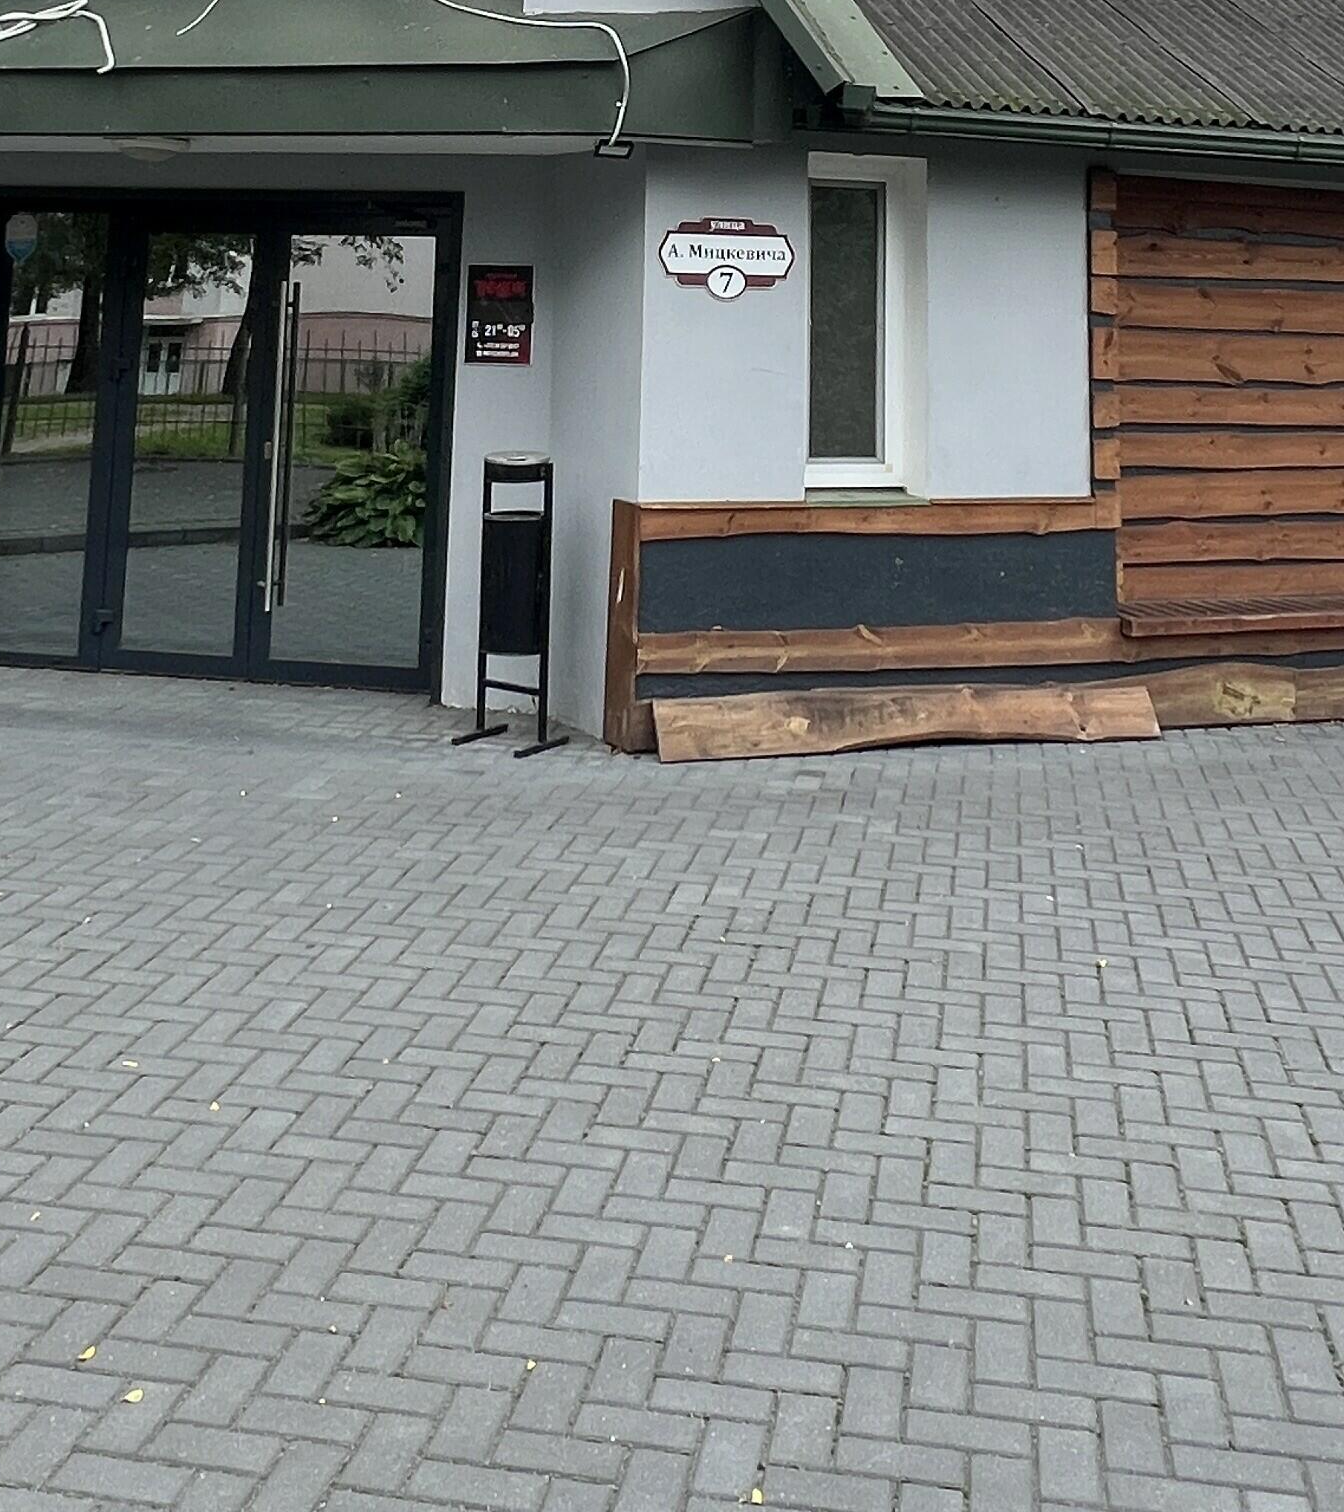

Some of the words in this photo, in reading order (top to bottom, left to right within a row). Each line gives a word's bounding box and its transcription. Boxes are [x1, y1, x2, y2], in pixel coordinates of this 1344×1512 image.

[710, 220, 746, 232] улица
[667, 243, 684, 259] А.
[689, 243, 787, 262] Мицкевича
[719, 272, 734, 294] 7
